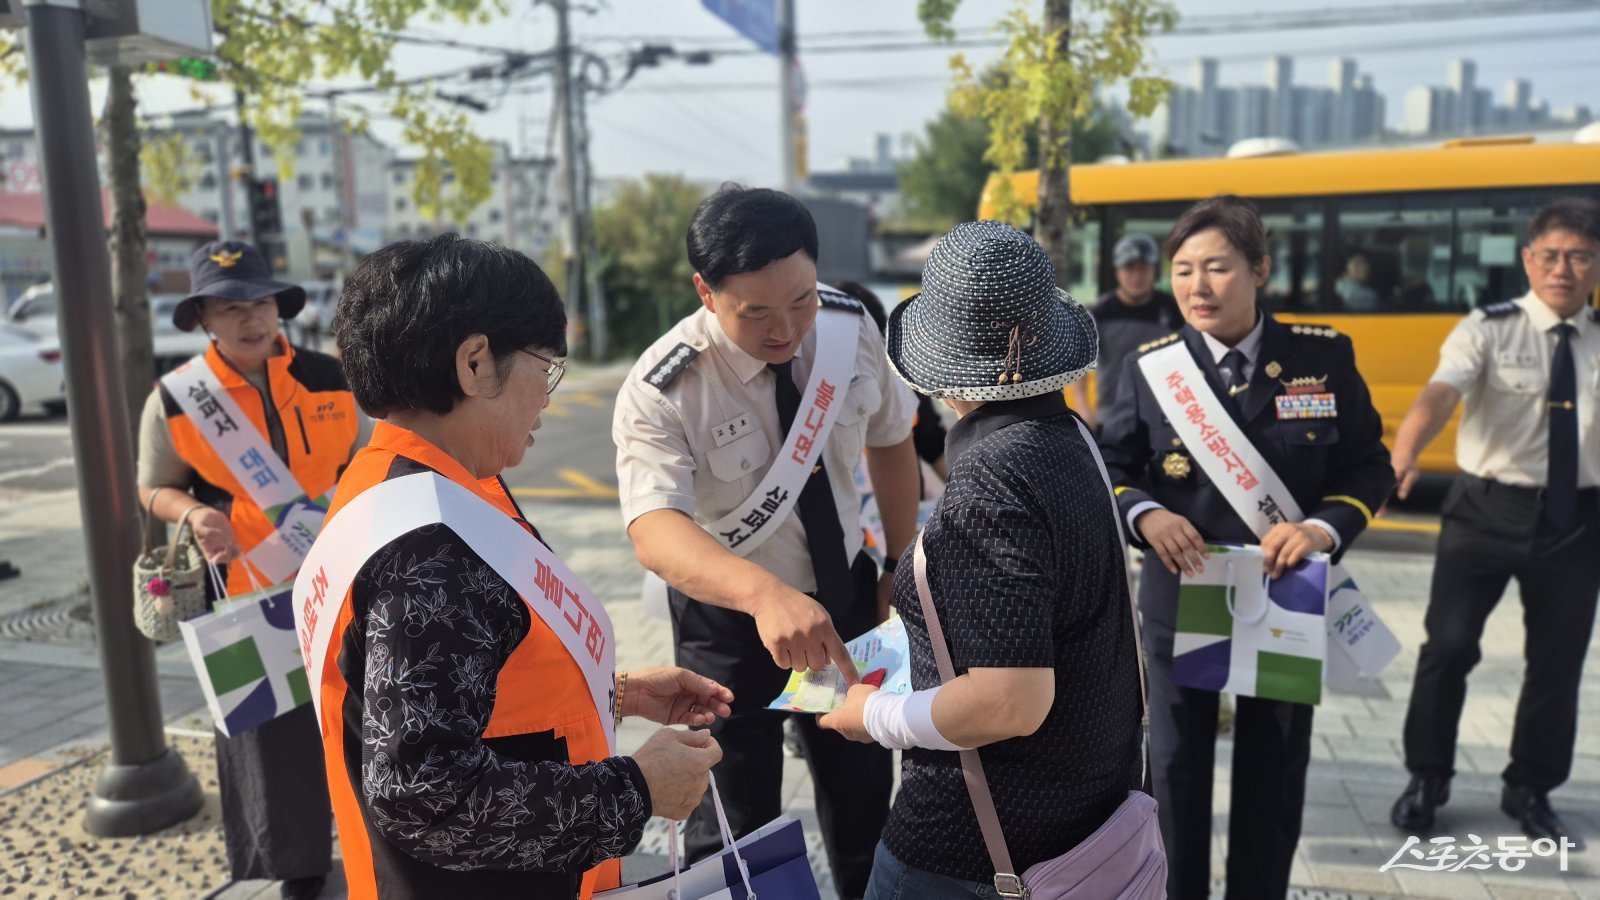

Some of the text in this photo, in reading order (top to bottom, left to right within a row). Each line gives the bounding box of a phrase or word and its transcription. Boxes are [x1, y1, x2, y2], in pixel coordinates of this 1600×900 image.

[188, 380, 279, 488] 살펴서 대피
[719, 378, 836, 548] 불나면 살펴서
[1165, 370, 1260, 491] 주택용소방시설
[534, 558, 606, 667] 불나면
